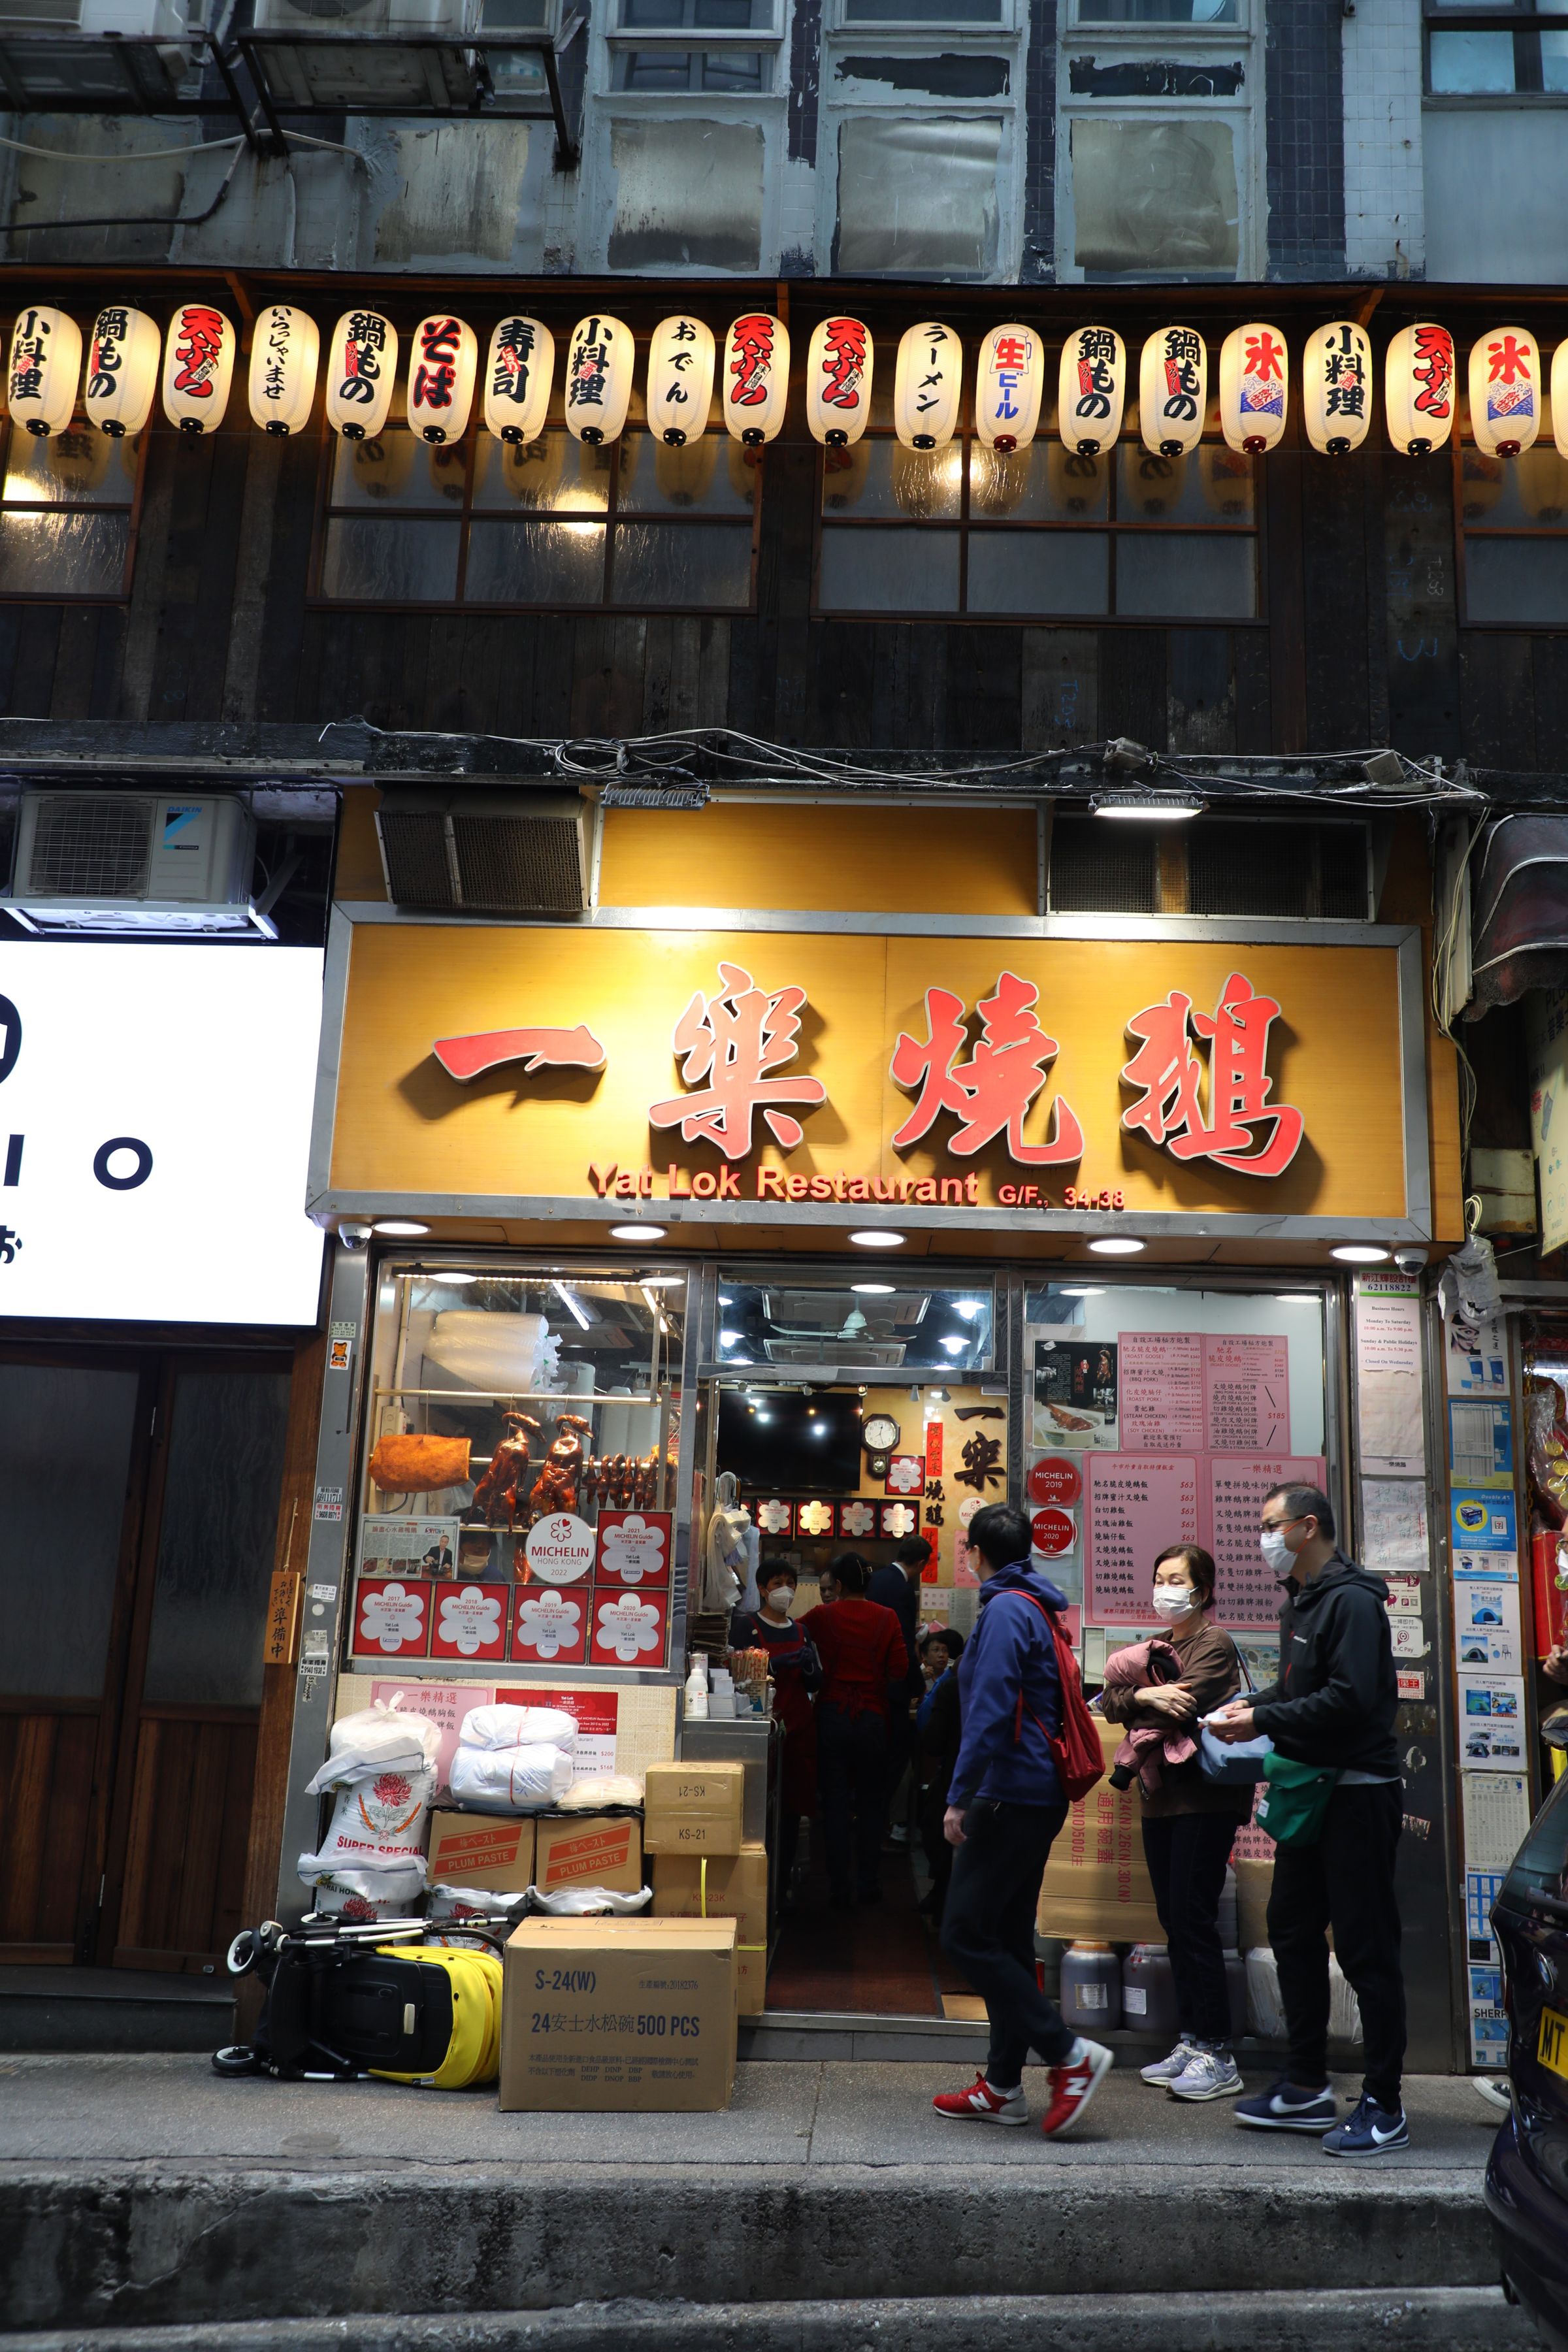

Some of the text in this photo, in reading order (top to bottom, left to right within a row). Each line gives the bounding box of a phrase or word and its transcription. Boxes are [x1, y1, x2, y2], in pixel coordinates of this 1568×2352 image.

[174, 308, 223, 398] 天ぷら
[263, 308, 292, 400] いらっしゃいませ
[339, 312, 387, 404] 鍋もの
[413, 318, 461, 409] そば
[568, 318, 613, 408] 小料理
[667, 321, 696, 403] おでん
[730, 316, 774, 406] 天ぷら
[822, 319, 866, 408] 天ぷら
[917, 325, 948, 412] ラーメン
[995, 338, 1025, 419] 生ビール
[1075, 329, 1116, 419] 鍋もの
[1164, 329, 1201, 421] 鍋もの
[1244, 332, 1284, 382] 氷
[1325, 325, 1365, 419] 小料理
[1414, 327, 1453, 418] 天ぷら
[1488, 335, 1531, 385] 氷
[433, 962, 1304, 1177] 一樂燒鵝
[589, 1162, 1126, 1208] Yat Lok Restaurant 34-38
[955, 1406, 1006, 1492] 一樂
[1243, 1464, 1283, 1474] 一樂精選
[925, 1479, 945, 1527] 燒鵝
[532, 1546, 589, 1558] MICHELIN
[270, 1607, 287, 1658] 準備中
[407, 1691, 457, 1704] 一樂精選
[679, 1786, 706, 1797] KS-21
[448, 1850, 510, 1870] PLUM PASTE
[459, 1833, 497, 1848] 梅ペースト
[569, 1836, 606, 1853] 梅ペースト
[679, 1829, 706, 1840] KS-21
[559, 1852, 621, 1877] PLUM PASTE
[535, 1969, 596, 1993] S-24(W)
[637, 2015, 666, 2036] 500
[670, 2016, 700, 2036] PCS
[1541, 2015, 1566, 2066] MT
